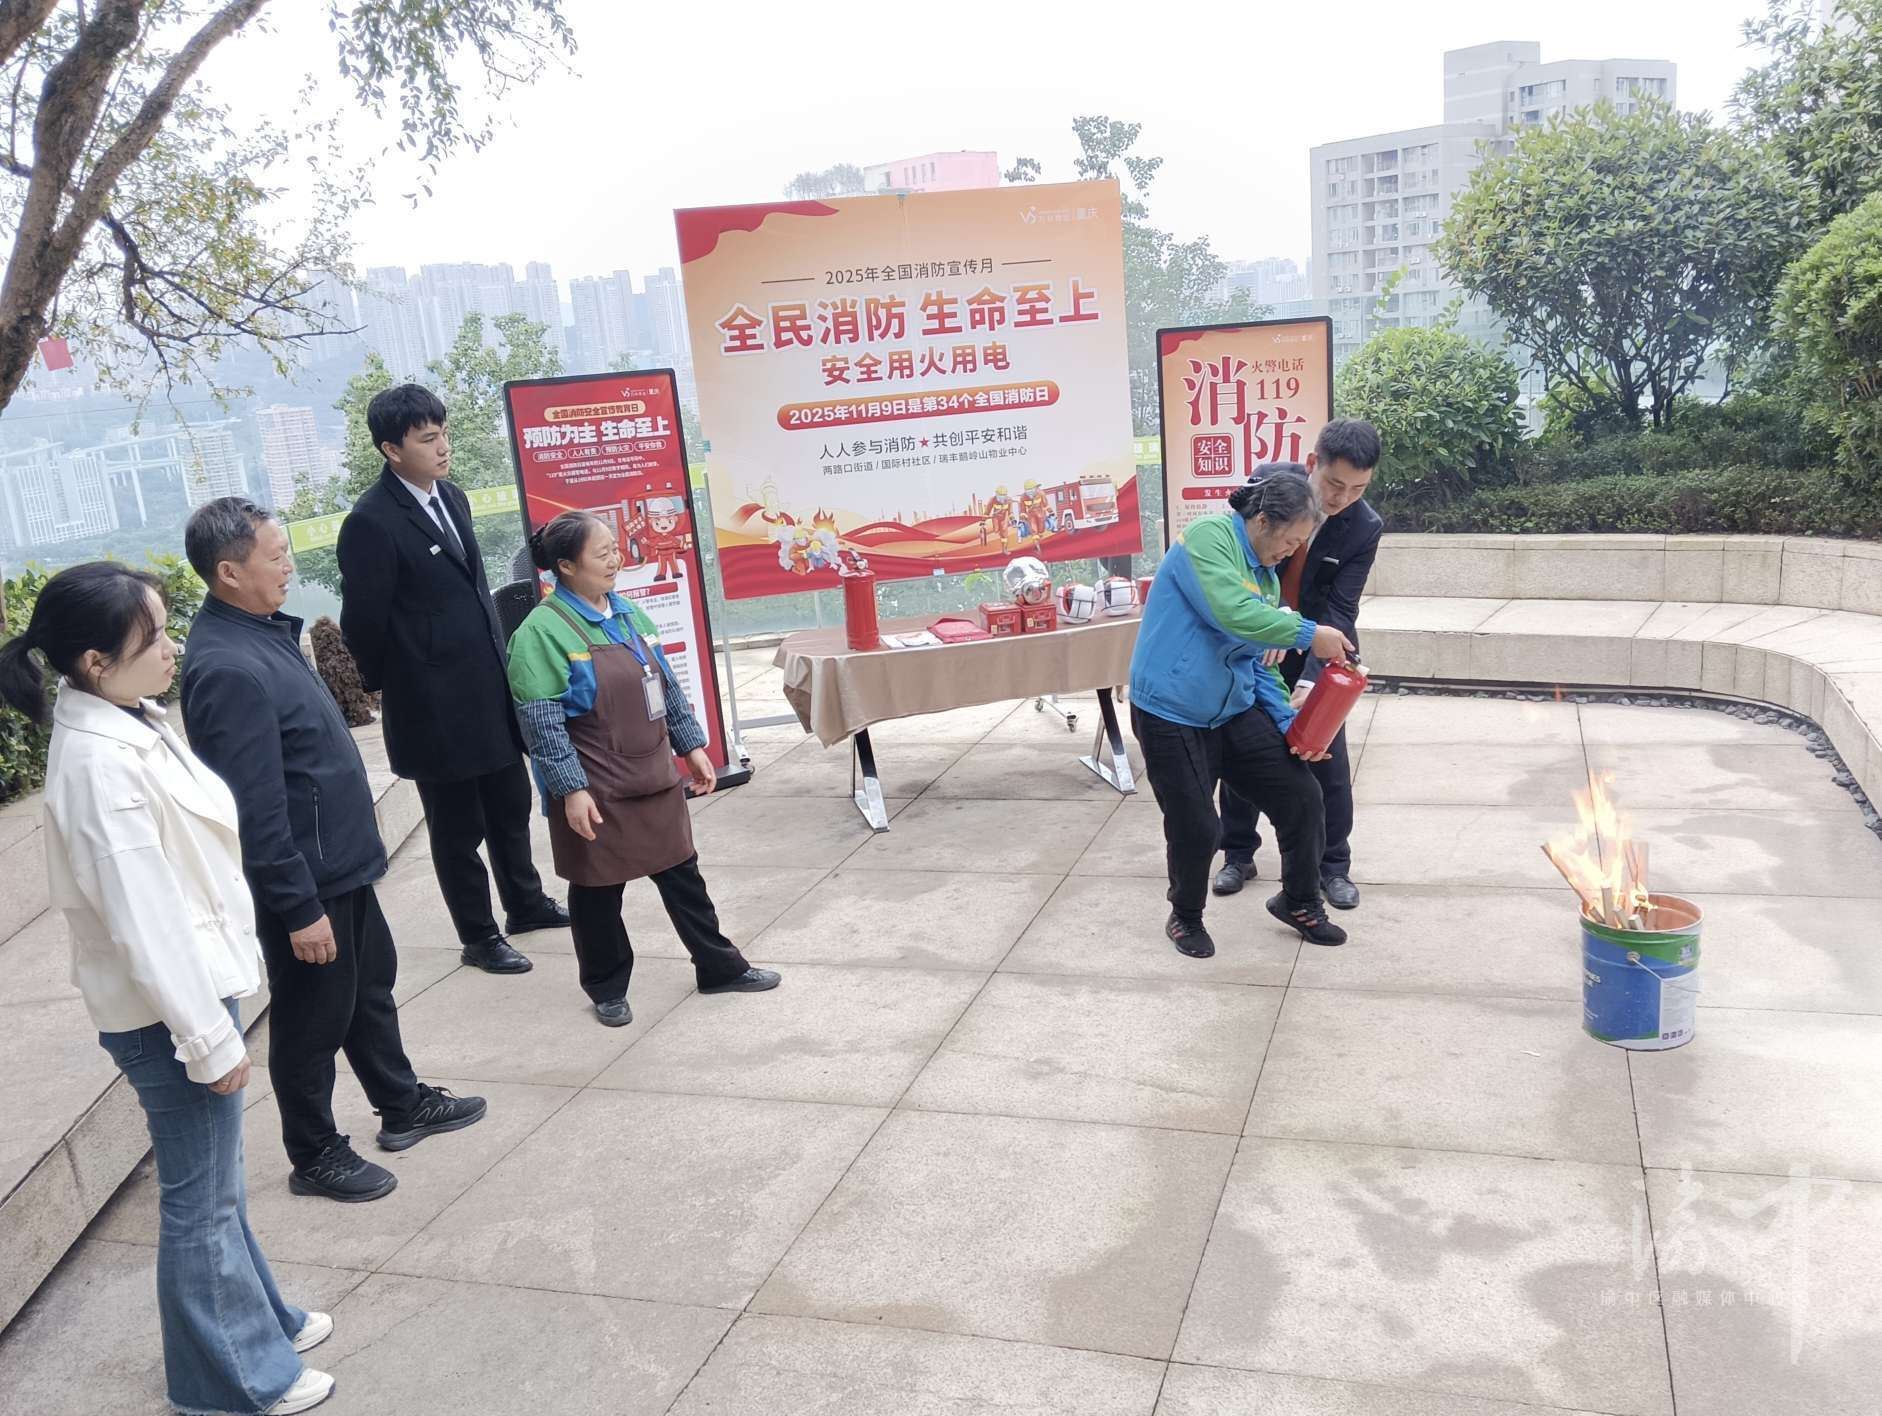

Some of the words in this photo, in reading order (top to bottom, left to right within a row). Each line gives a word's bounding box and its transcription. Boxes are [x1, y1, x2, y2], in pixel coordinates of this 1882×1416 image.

[825, 258, 993, 285] 2025年全国消防宣传月
[718, 294, 906, 353] 全民消防
[919, 279, 1100, 336] 生命至上
[820, 341, 1011, 386] 安全用火用电
[1251, 358, 1304, 374] 火警电话
[788, 387, 1050, 425] 2025年11月9日是第34个全国消防日
[1256, 377, 1301, 400] 119
[522, 421, 598, 449] 预防为主
[601, 415, 672, 442] 生命至上
[818, 435, 917, 461] 人人参与消防
[932, 424, 1029, 450] 共创平安和谐
